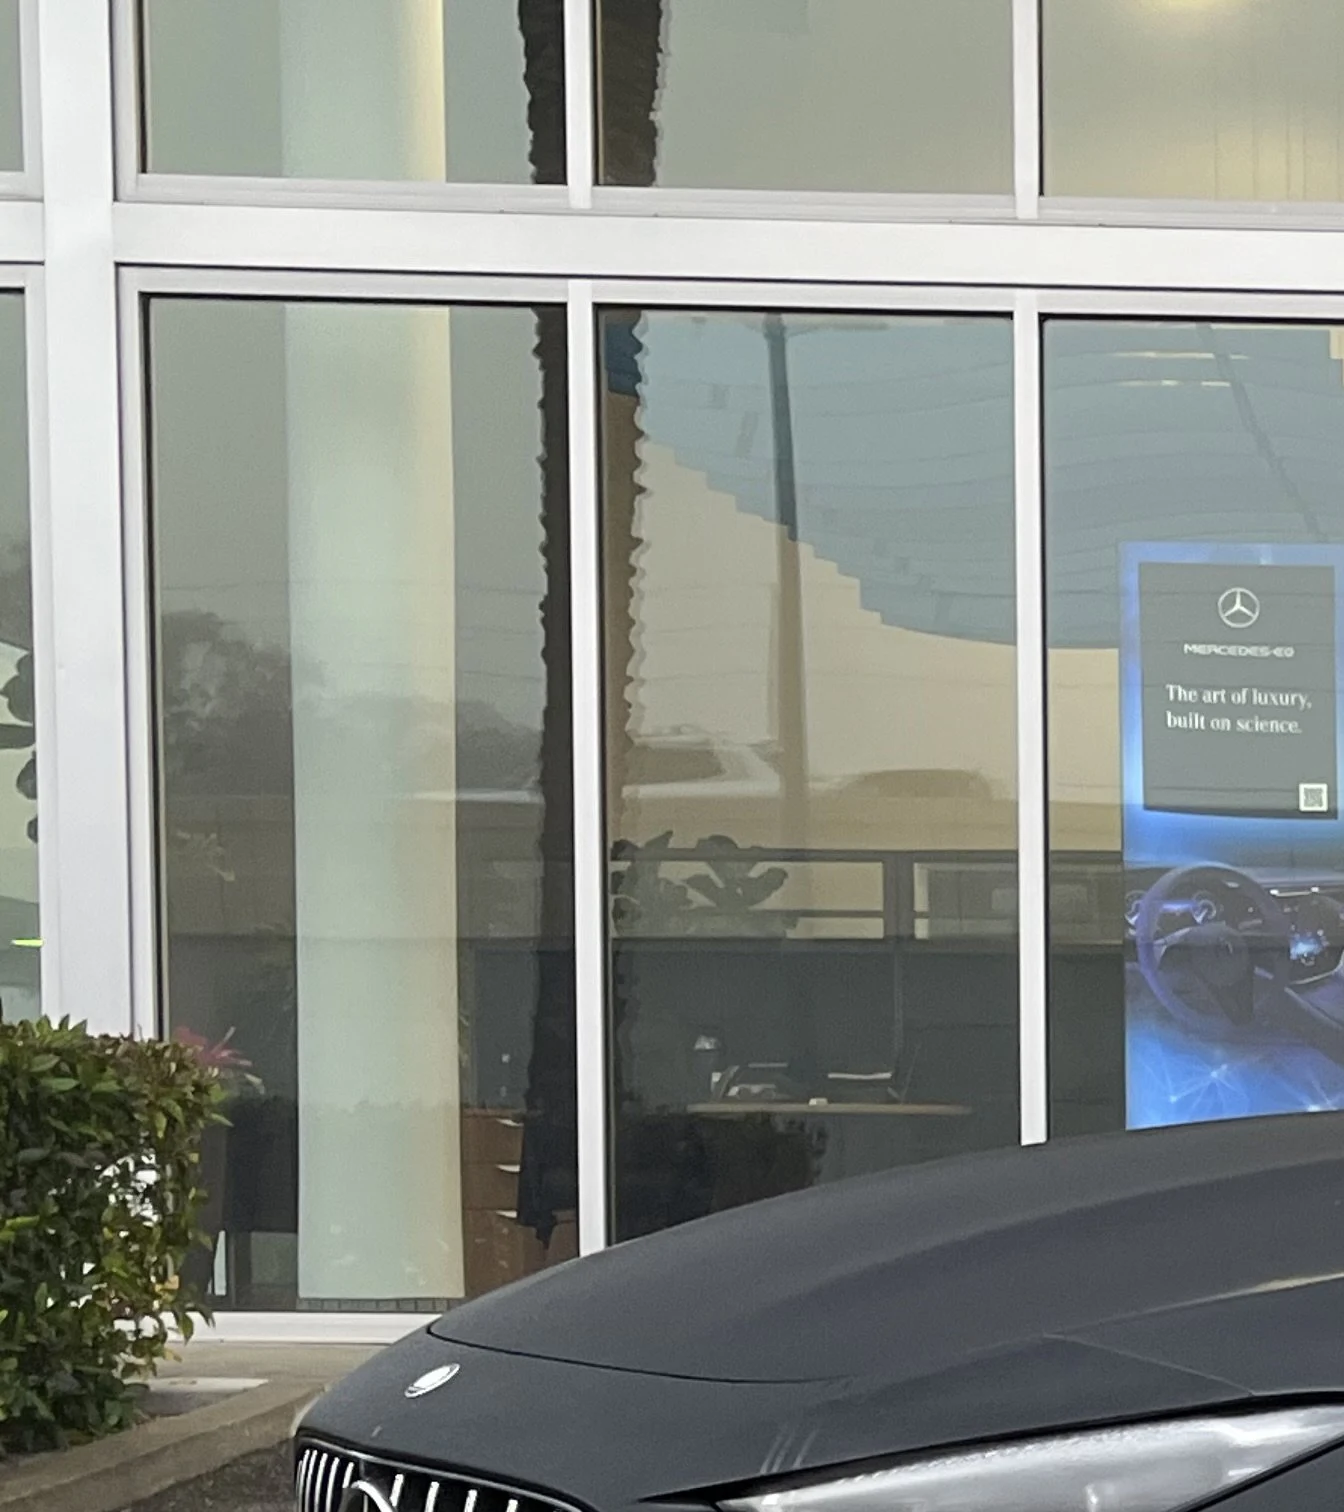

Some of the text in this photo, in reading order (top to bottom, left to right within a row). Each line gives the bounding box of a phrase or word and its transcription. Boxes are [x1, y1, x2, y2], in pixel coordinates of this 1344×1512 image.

[1165, 683, 1313, 712] The art of luxury,
[1165, 710, 1303, 735] built on science.
